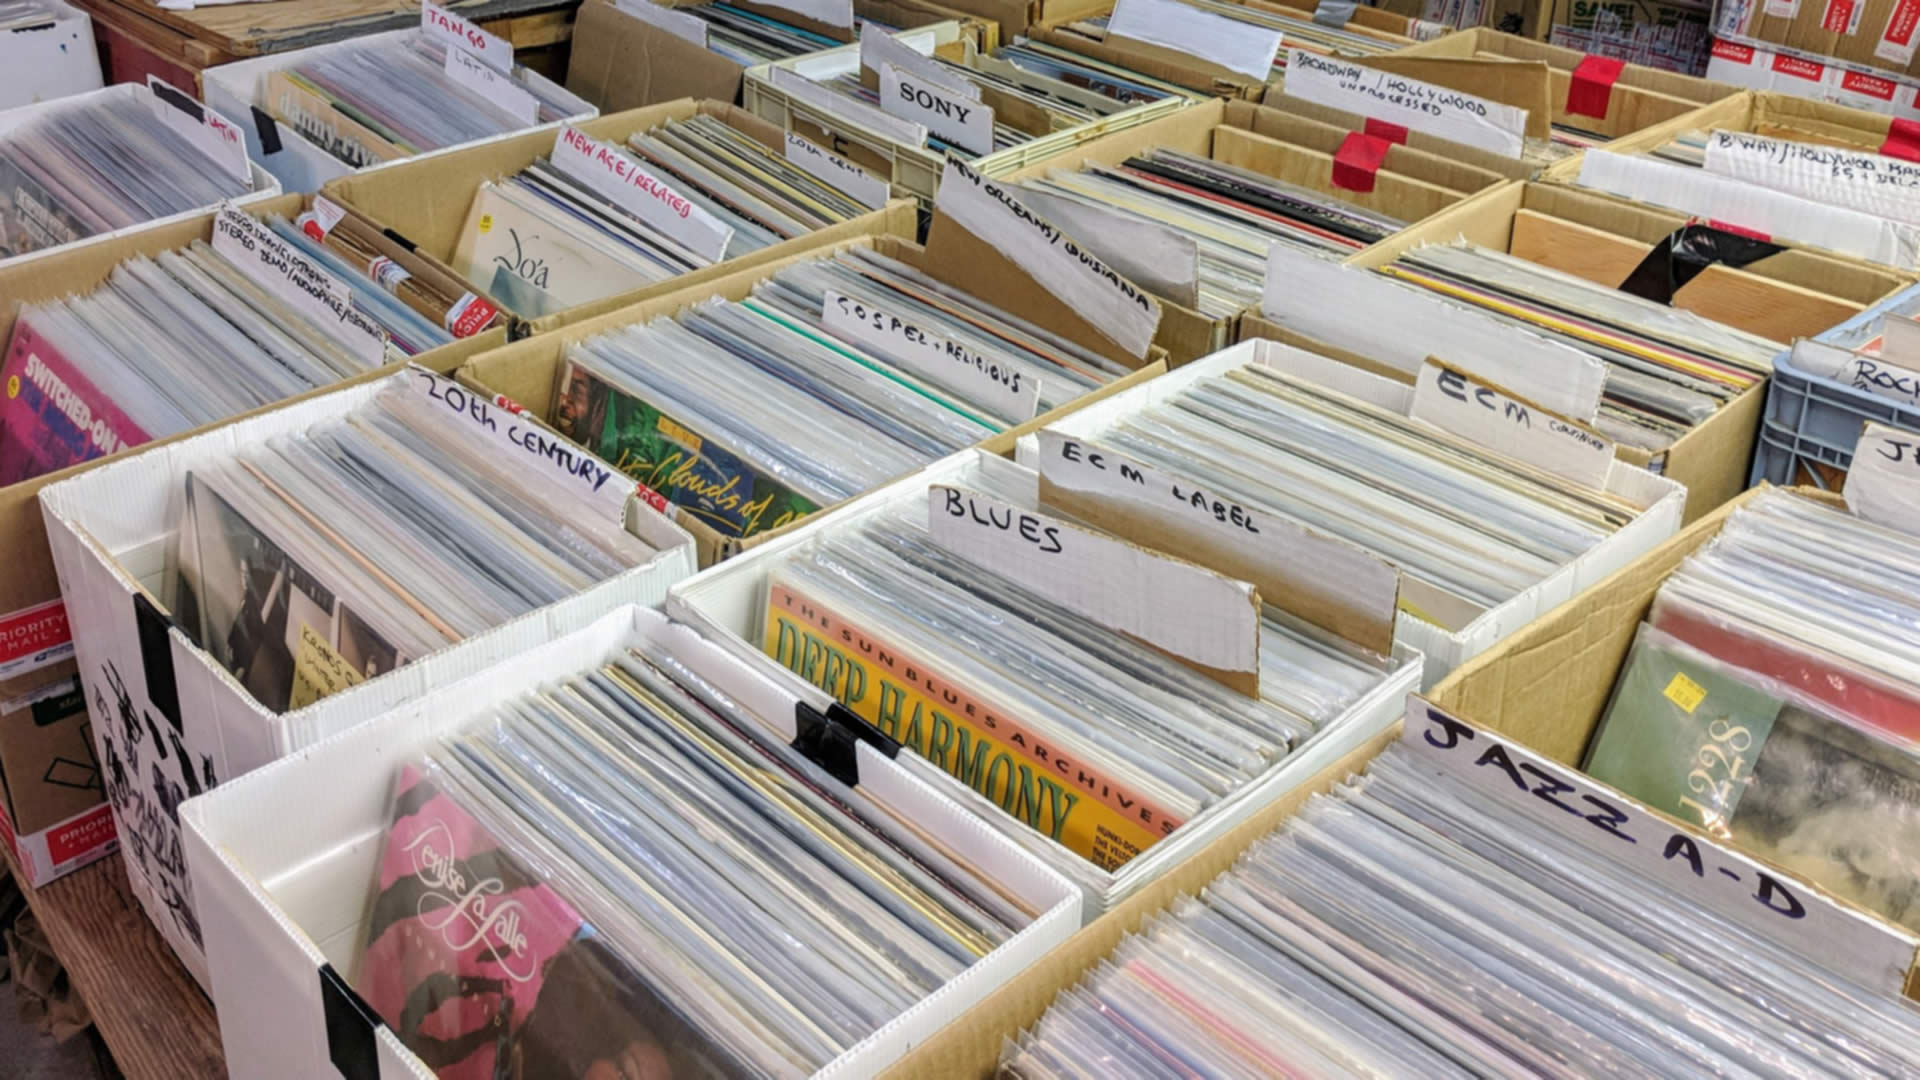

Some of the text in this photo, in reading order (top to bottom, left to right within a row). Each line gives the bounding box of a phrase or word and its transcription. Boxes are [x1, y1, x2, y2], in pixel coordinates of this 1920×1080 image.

[427, 8, 486, 49] TANGO
[455, 49, 494, 82] LATIN
[1296, 51, 1363, 82] BROADWAY
[207, 115, 238, 143] LATIN
[899, 81, 972, 125] SONY
[563, 128, 595, 157] NEW
[947, 154, 981, 187] NEW
[836, 296, 928, 347] GOSPEL
[945, 340, 1022, 394] RELIGIOUS
[1436, 366, 1531, 430] ECM
[419, 372, 497, 432] 20th
[507, 425, 612, 492] CENTURY
[648, 451, 741, 511] Clouds
[1061, 440, 1260, 533] ECM LABEL
[944, 487, 1063, 553] BLUES
[7, 633, 49, 652] MAIL
[776, 616, 1079, 842] DEEP HARMONY
[784, 594, 1176, 836] THE SUN BLUES ARCHIVES
[1423, 708, 1637, 844] JAZZ
